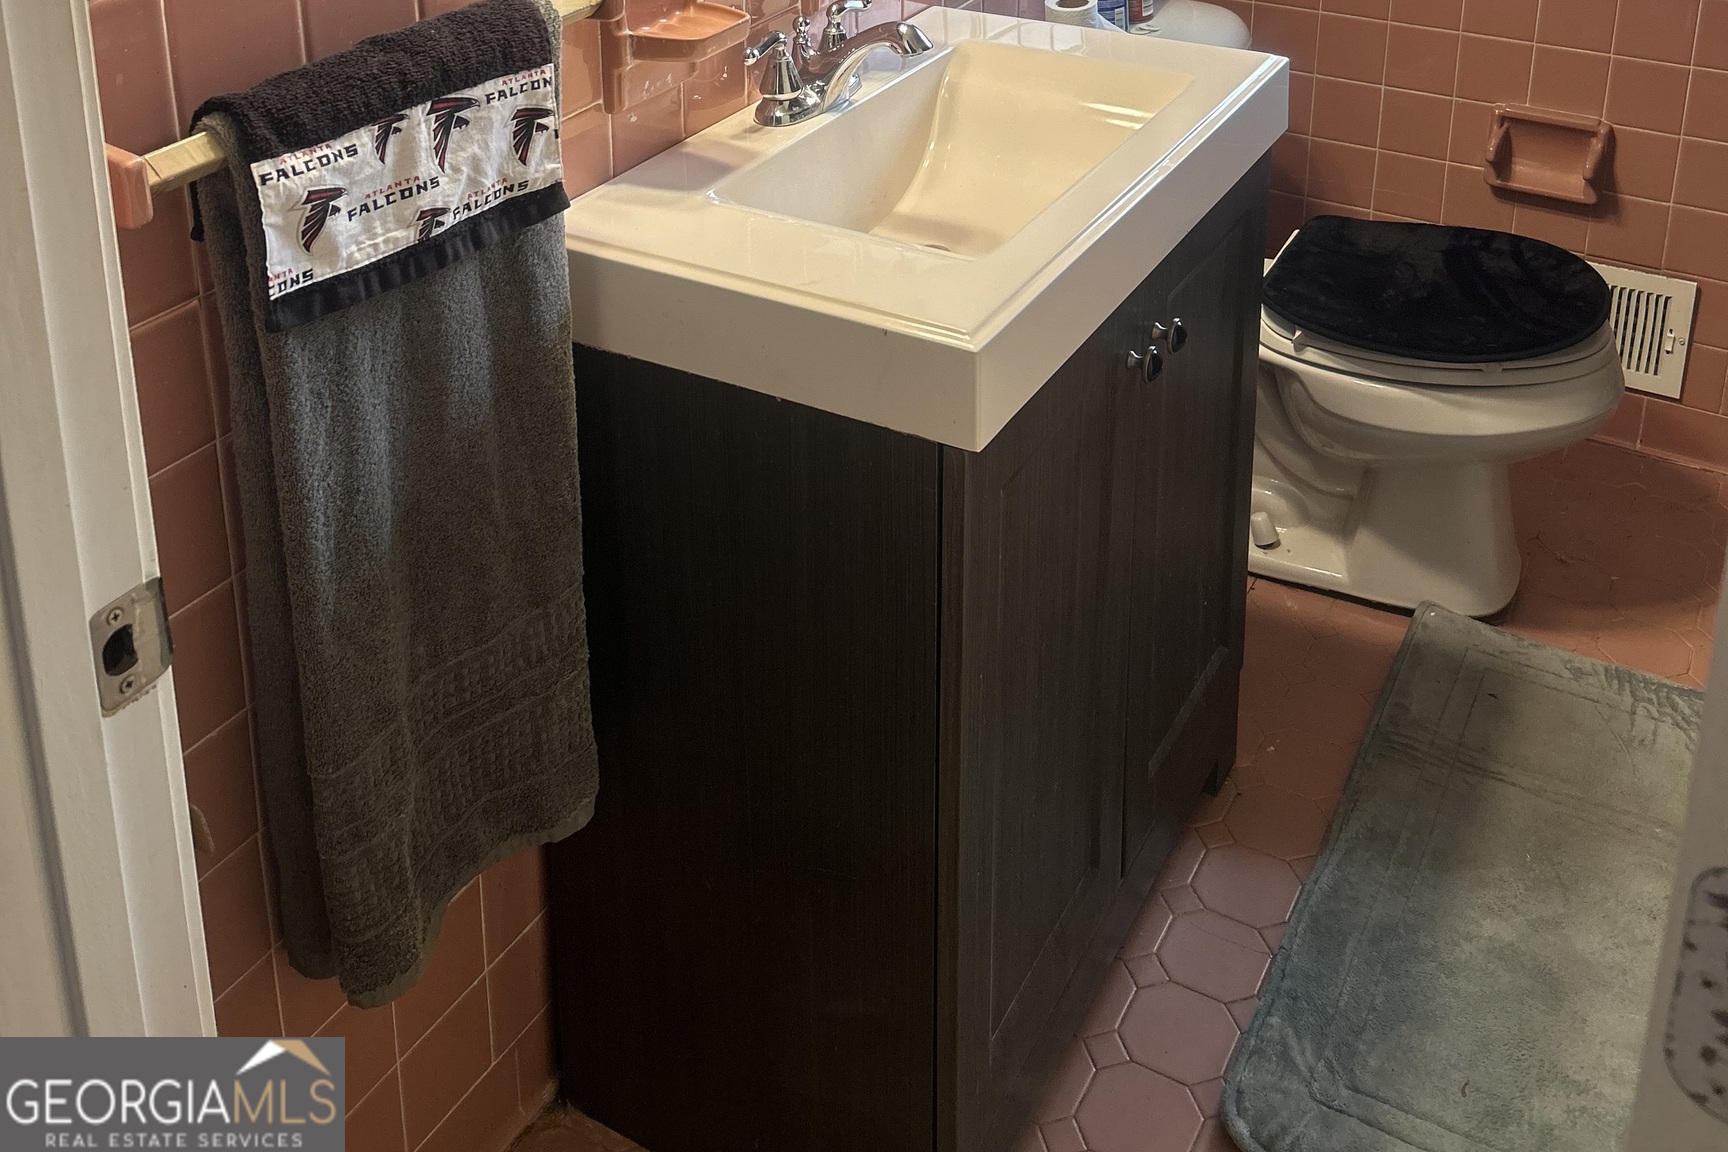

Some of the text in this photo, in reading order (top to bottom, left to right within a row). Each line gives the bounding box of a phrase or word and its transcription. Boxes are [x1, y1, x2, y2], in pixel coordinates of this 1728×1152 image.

[484, 76, 552, 105] FALCON
[501, 68, 547, 87] ATLANTA
[258, 143, 359, 186] FALCONS
[279, 142, 333, 165] ATLANTA
[346, 175, 441, 223] FALCONS
[364, 175, 421, 200] ATLANTA
[452, 179, 530, 221] FALCONS
[466, 177, 508, 200] ATLANTA
